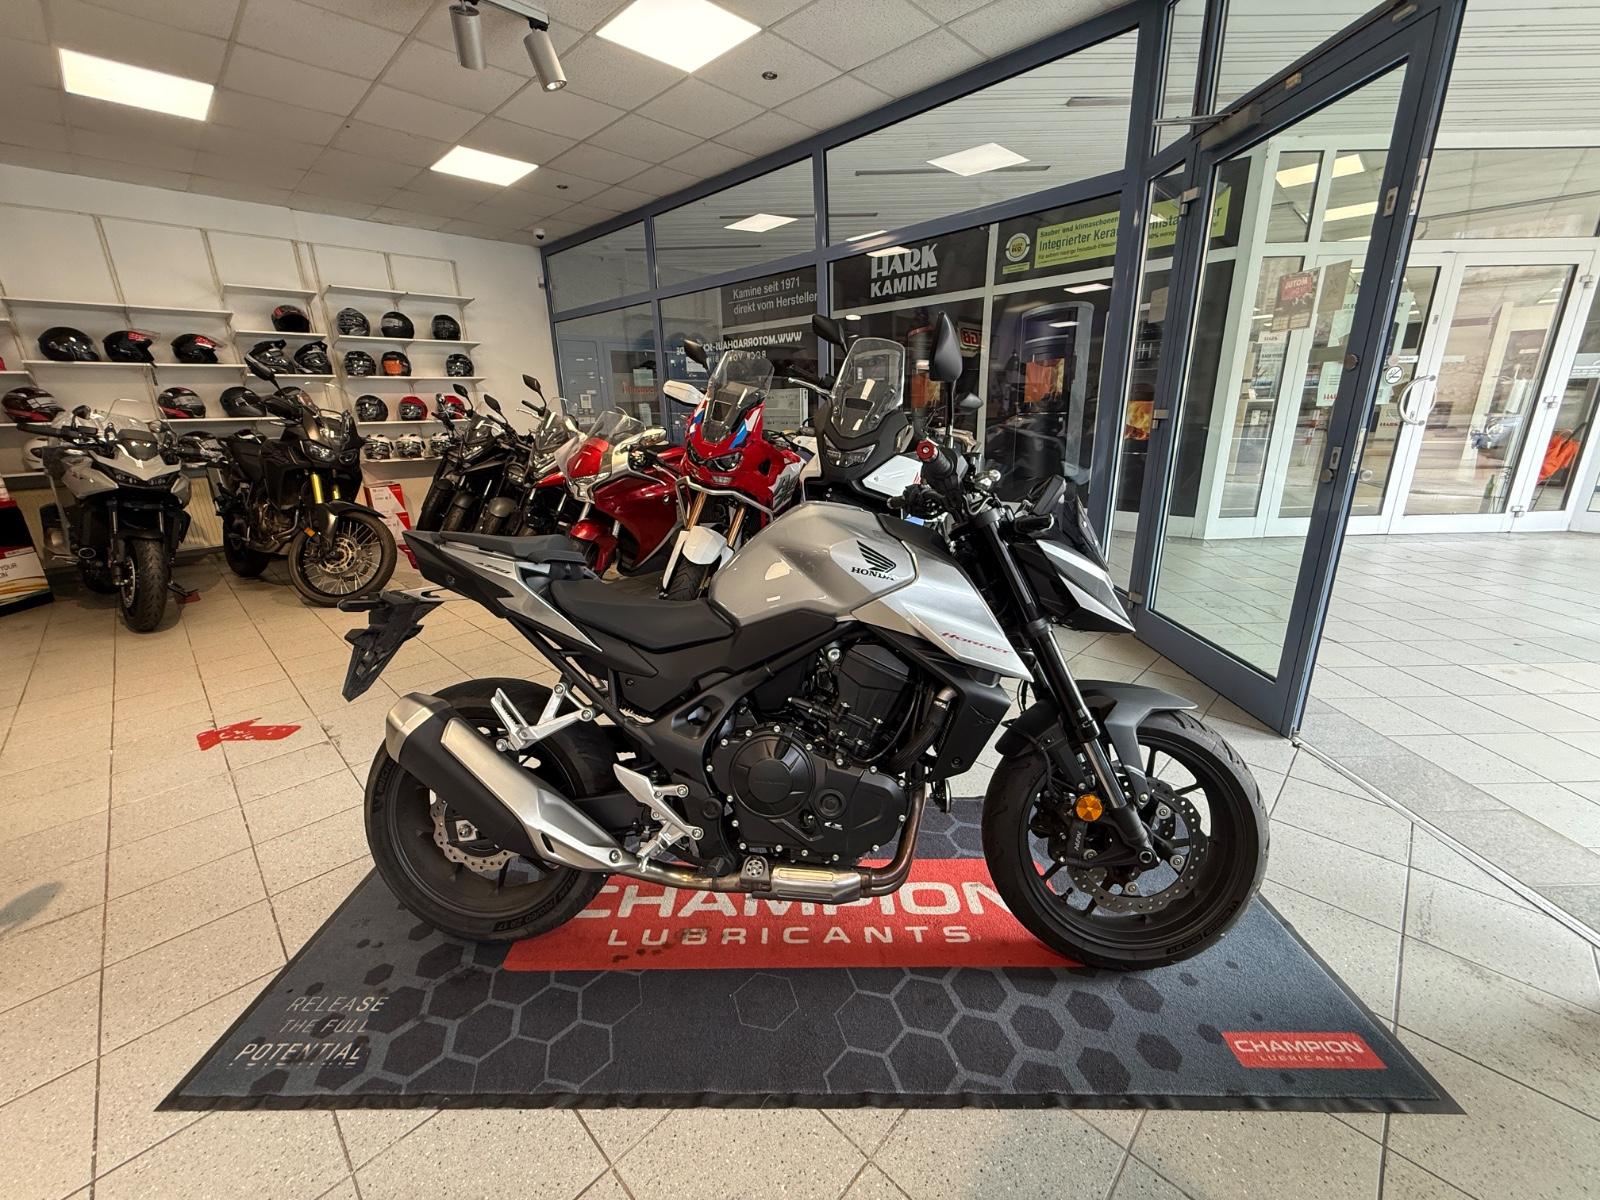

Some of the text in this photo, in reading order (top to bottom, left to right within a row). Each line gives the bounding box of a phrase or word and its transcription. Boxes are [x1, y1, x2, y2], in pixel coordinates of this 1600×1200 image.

[1062, 225, 1074, 234] und
[1075, 216, 1119, 230] klimaschonen
[1039, 232, 1091, 251] Integrierter
[1093, 228, 1117, 241] Kera
[871, 243, 938, 279] HARK
[733, 276, 800, 300] Kamine seit 1971
[870, 271, 938, 298] KAMINE
[733, 291, 817, 315] direkt vom Hersteller
[850, 566, 895, 581] HONDA
[607, 926, 972, 946] LUBRICANTS
[286, 996, 389, 1012] RELEASE
[280, 1018, 369, 1033] THE FULL
[226, 1042, 362, 1070] POTENTIAL
[1234, 1040, 1366, 1053] CHAMPION
[1260, 1054, 1354, 1062] LUBRICANTS
